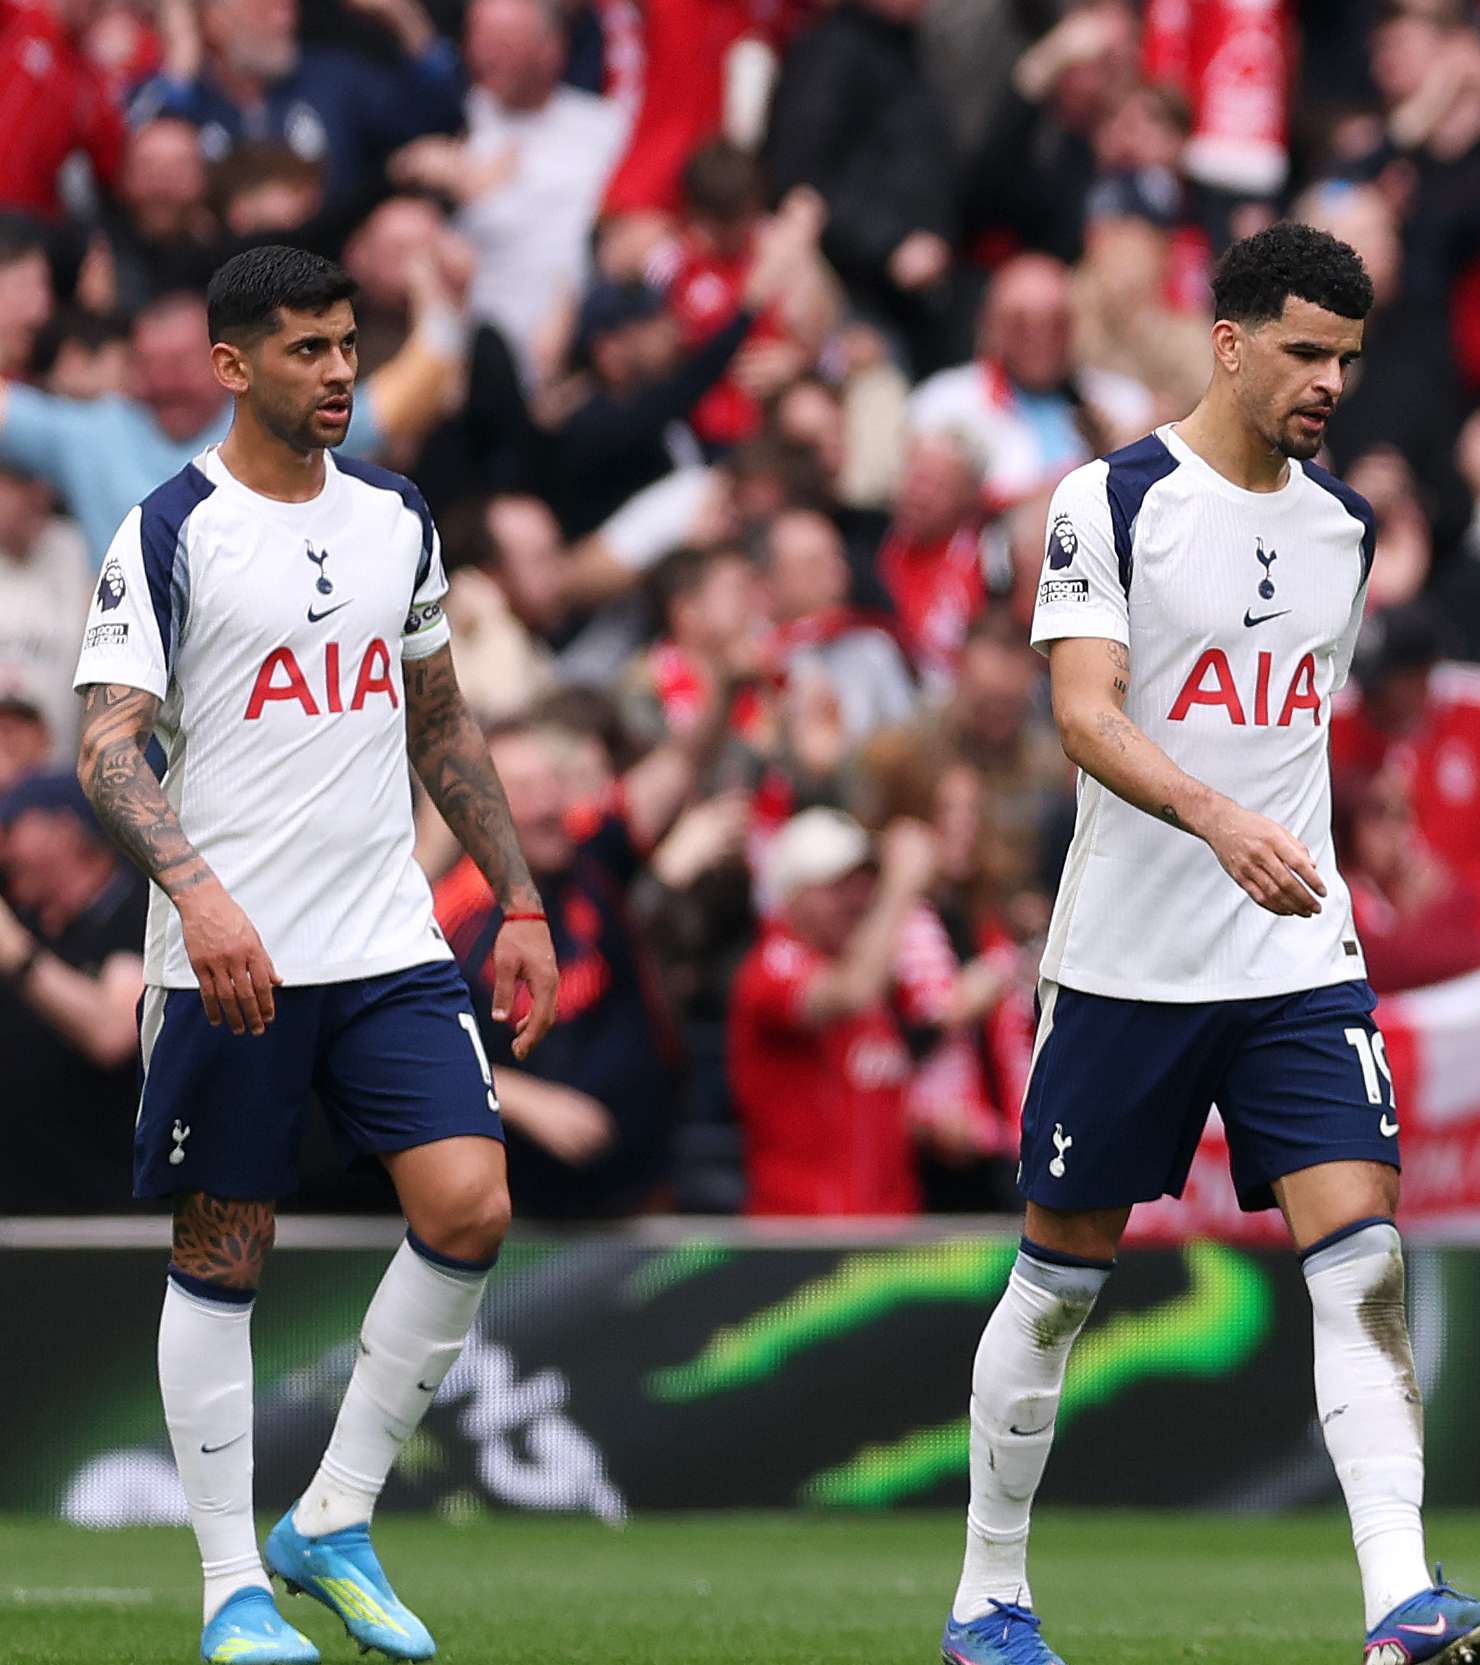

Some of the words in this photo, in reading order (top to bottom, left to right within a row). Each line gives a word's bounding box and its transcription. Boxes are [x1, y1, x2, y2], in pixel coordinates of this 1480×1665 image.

[1049, 580, 1083, 593] room
[245, 638, 399, 720] AIA
[1167, 648, 1321, 727] AIA
